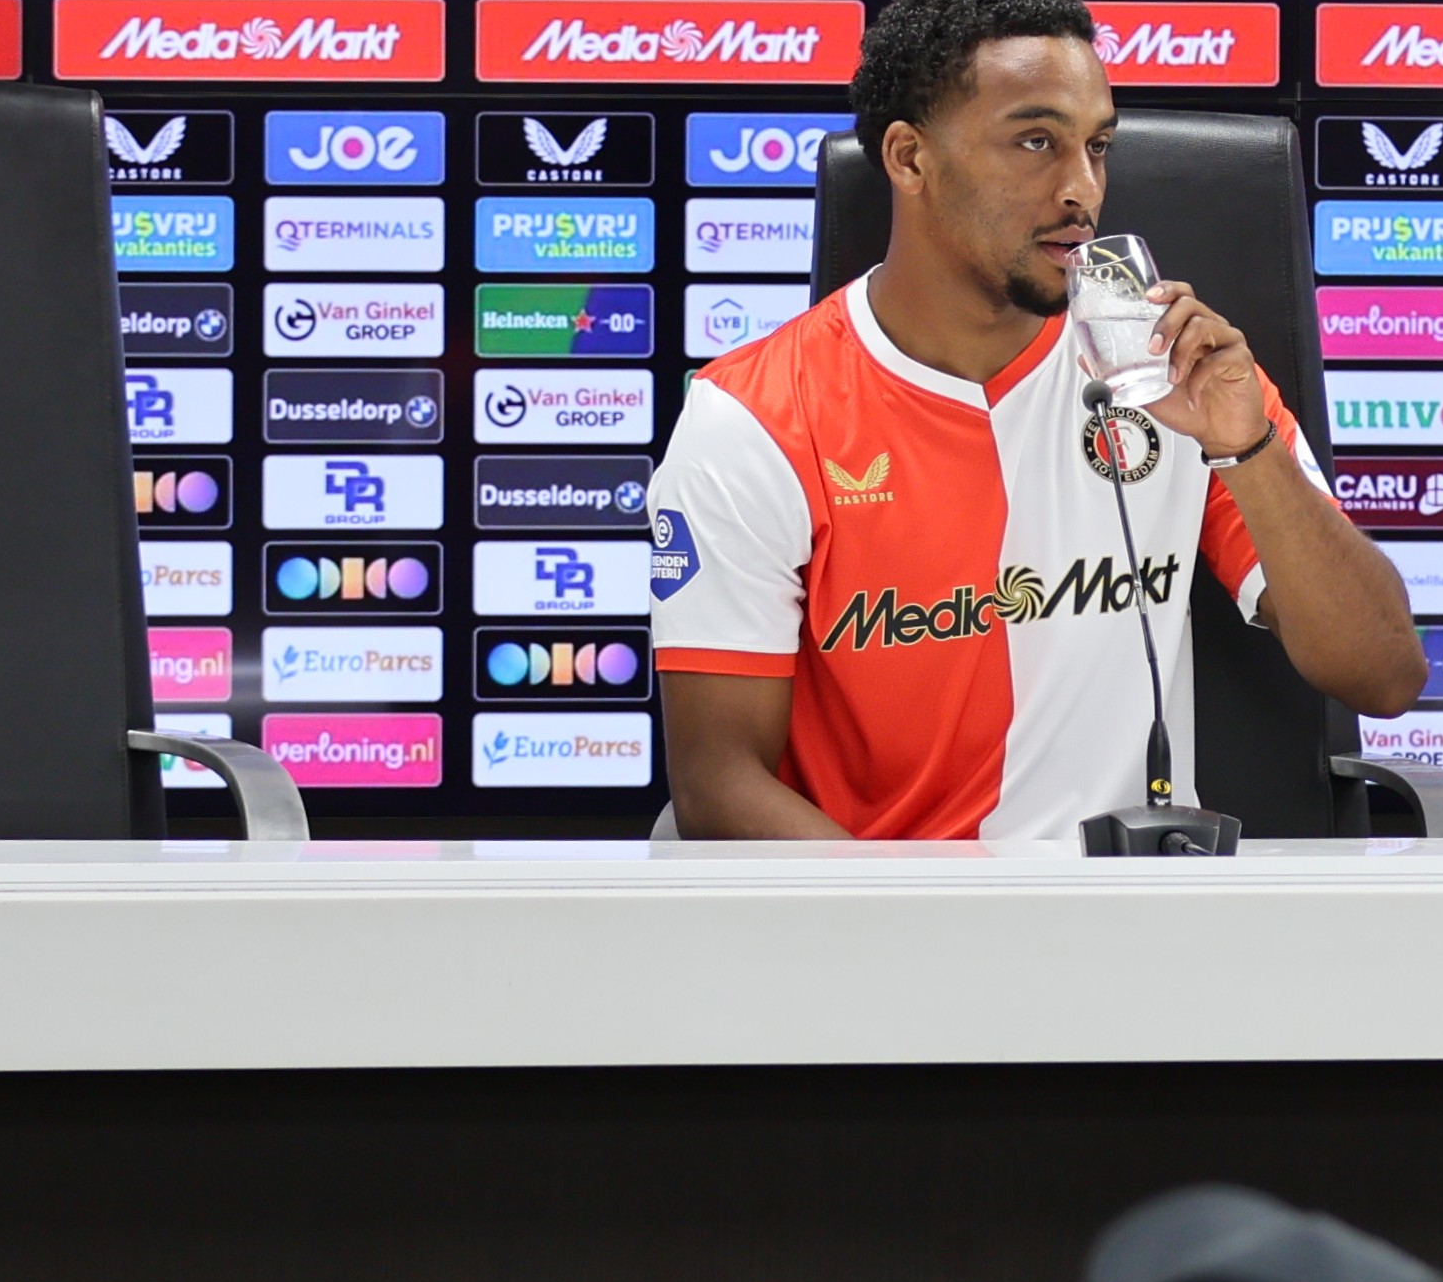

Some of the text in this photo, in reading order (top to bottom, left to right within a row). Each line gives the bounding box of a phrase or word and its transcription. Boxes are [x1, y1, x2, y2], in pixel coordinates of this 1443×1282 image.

[288, 124, 417, 170] JOE
[527, 170, 602, 181] CASTORE
[1365, 174, 1439, 186] CASTORE
[276, 220, 433, 243] QTERMINALS
[534, 239, 636, 257] vakanties
[318, 302, 434, 320] Van Ginkel
[483, 313, 569, 329] Heineken
[346, 325, 415, 339] GROEP
[527, 388, 643, 406] Van Ginkel
[270, 398, 401, 423] Dusseldorp
[556, 411, 625, 426] GROEP
[480, 484, 611, 509] Dusseldorp
[834, 490, 894, 506] CASTORE
[325, 515, 384, 523] GROUP
[535, 601, 594, 609] GROUP
[304, 649, 432, 671] EuroParcs
[271, 731, 434, 769] verloning.nl
[514, 735, 642, 757] EuroParcs
